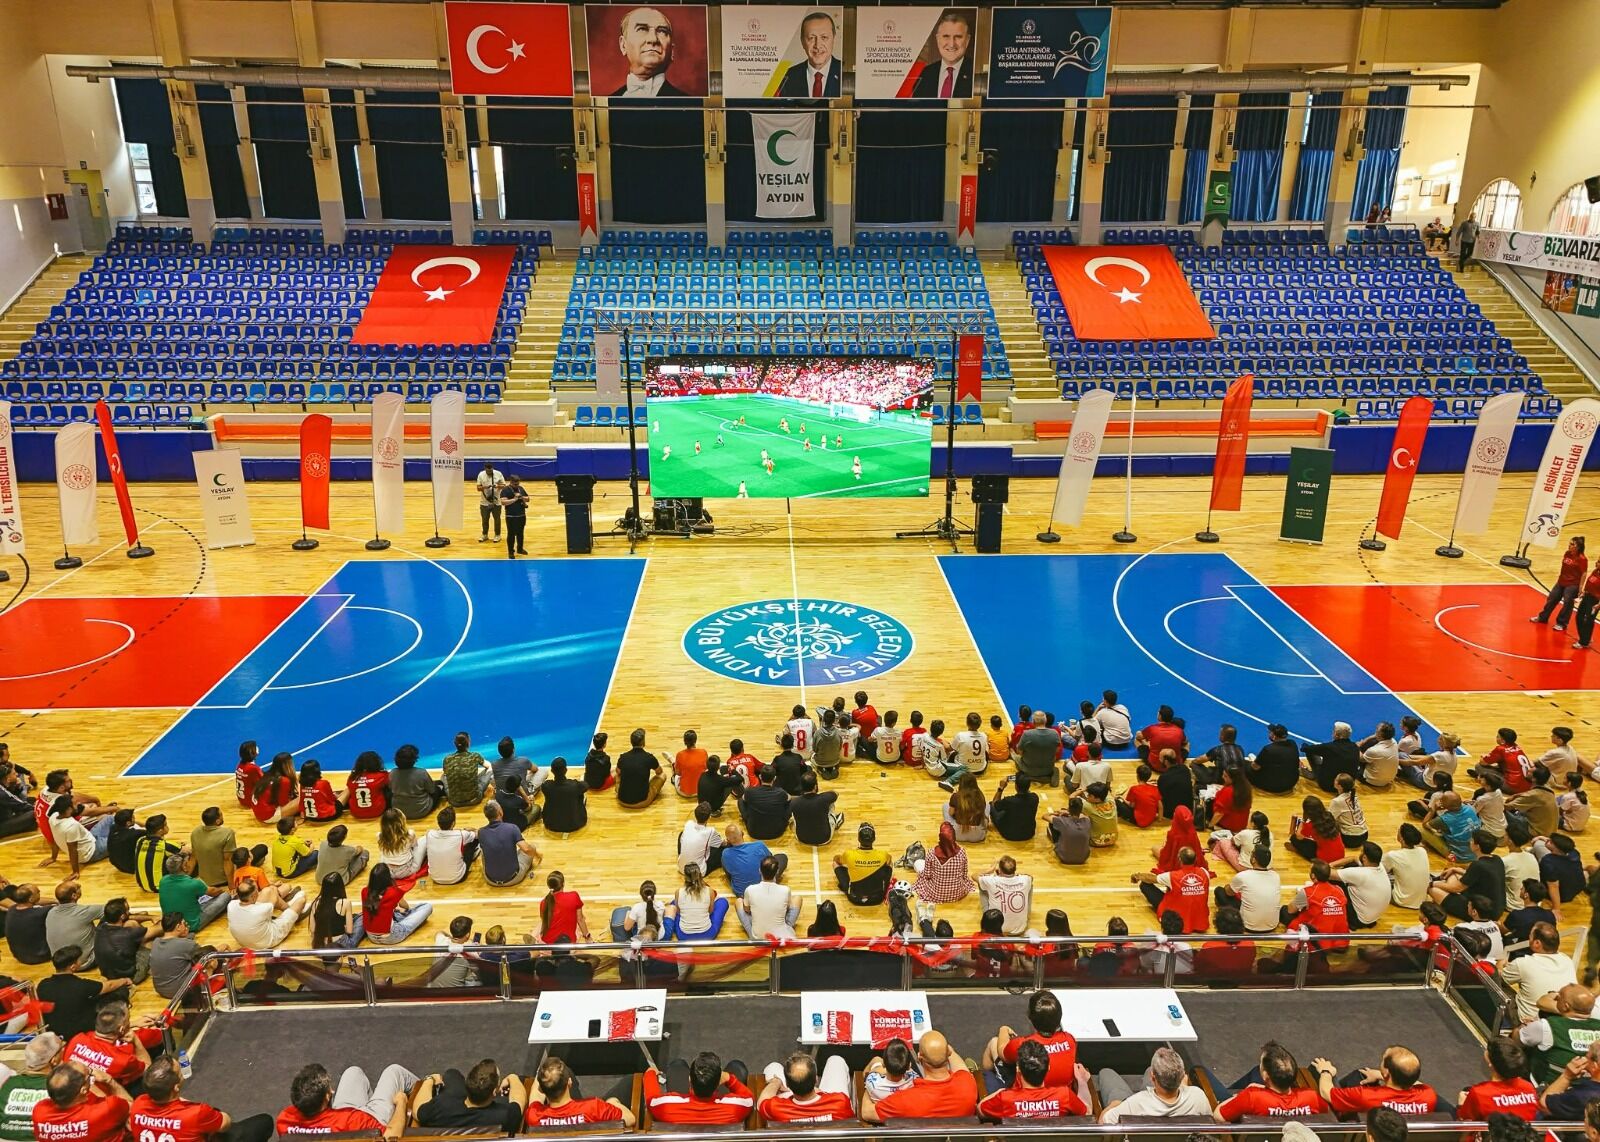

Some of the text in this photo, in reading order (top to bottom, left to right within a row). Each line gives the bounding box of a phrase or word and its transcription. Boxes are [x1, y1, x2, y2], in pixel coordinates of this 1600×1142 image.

[766, 193, 804, 203] AYDIN
[1544, 456, 1564, 493] BİSİKLET
[1552, 444, 1584, 510] İL TEMSİLCİLİĞİ
[698, 602, 902, 682] AYDIN BÜYÜKŞEHİR BELEDİYESİ
[796, 729, 806, 751] 8
[884, 742, 894, 754] 8
[972, 740, 982, 756] 9
[994, 890, 1026, 914] 10
[74, 1044, 114, 1066] TÜRKİYE
[1044, 1041, 1070, 1054] RKİYE
[1015, 1100, 1060, 1111] TÜRKİYE
[1492, 1092, 1537, 1106] TÜRKİYE
[1268, 1106, 1312, 1116] TÜRKİYE
[38, 1120, 89, 1133] TÜRKİYE
[134, 1114, 182, 1130] TÜRKİYE
[540, 1114, 584, 1126] TÜRKİYE
